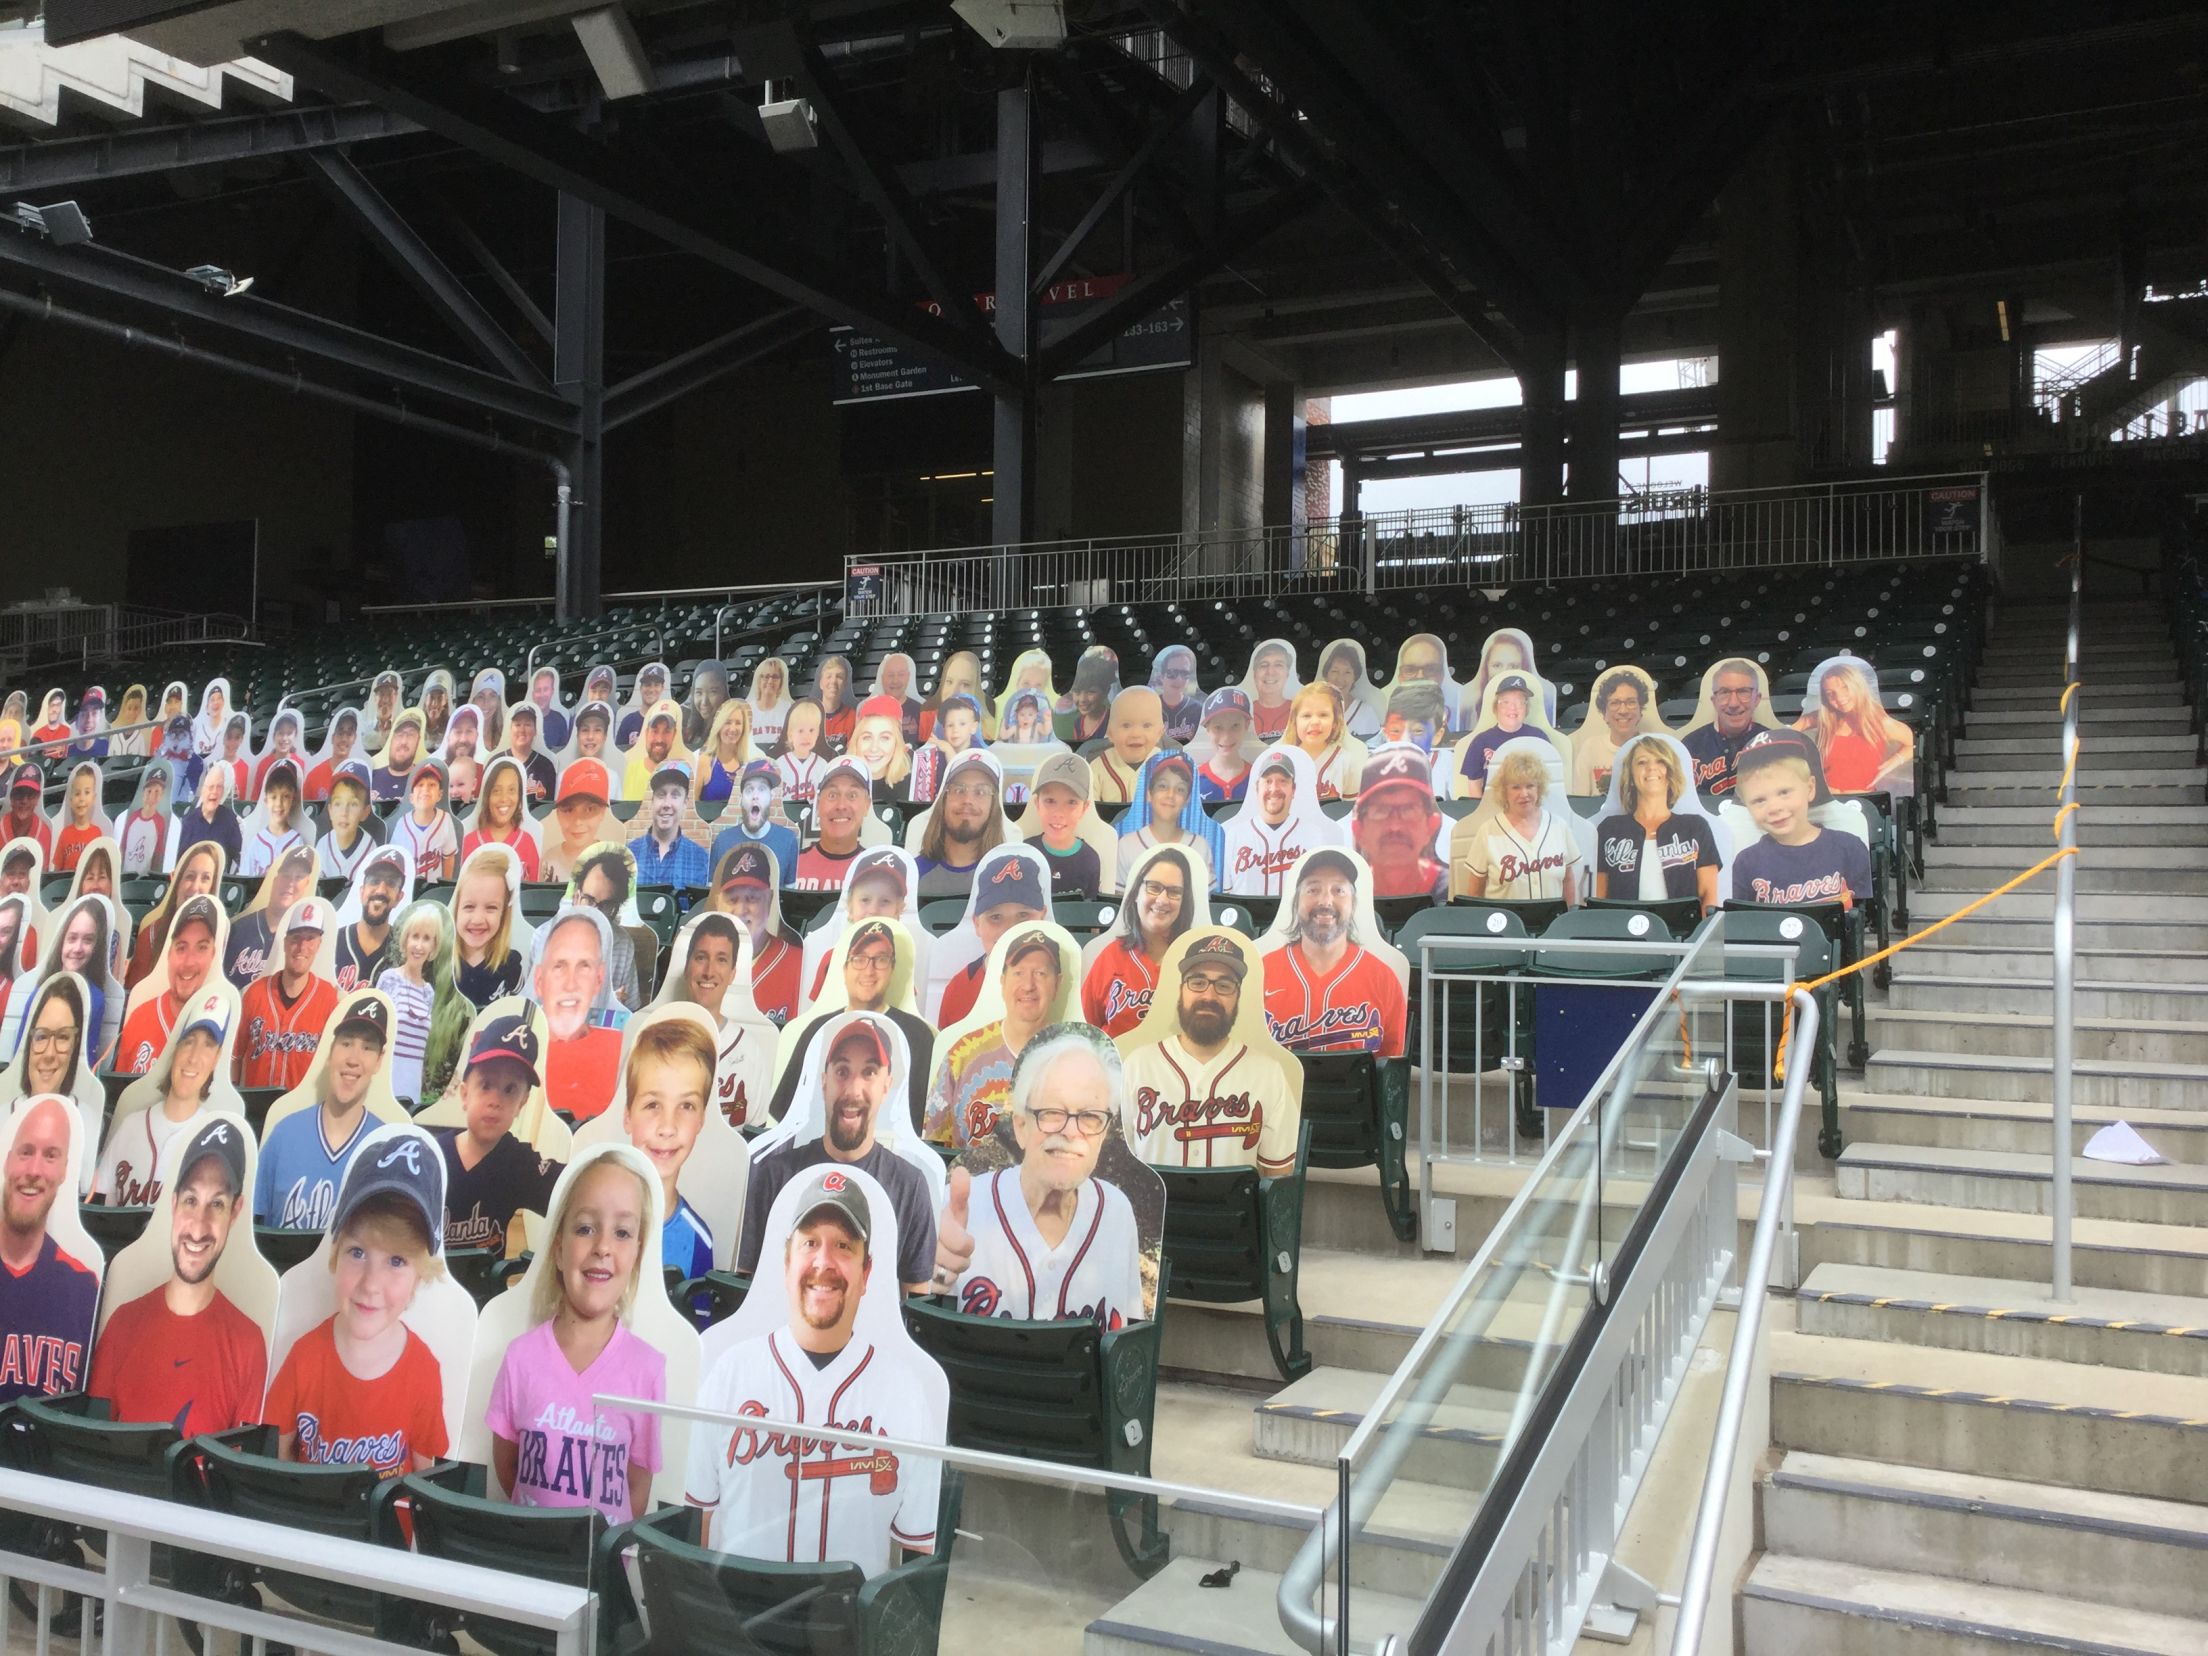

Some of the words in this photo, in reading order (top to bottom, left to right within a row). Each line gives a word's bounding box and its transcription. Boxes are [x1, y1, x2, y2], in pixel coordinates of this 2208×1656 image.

[849, 336, 873, 348] Suites
[858, 345, 898, 358] Restrooms
[859, 358, 894, 369] Elevators
[859, 368, 899, 381] Monument
[900, 365, 927, 377] Garden
[860, 384, 873, 393] 1st
[875, 383, 893, 392] Base
[895, 380, 913, 389] Gate
[1929, 488, 1977, 501] CAUTION
[851, 566, 880, 576] CAUTION
[1235, 845, 1302, 875] Braves
[1499, 852, 1565, 885] Braves
[1751, 870, 1842, 905] Braves
[1136, 1085, 1251, 1141] Braves
[534, 1402, 616, 1442] Atlanta
[727, 1400, 873, 1469] Braves
[296, 1411, 403, 1467] Braves
[518, 1429, 627, 1508] BRAVES
